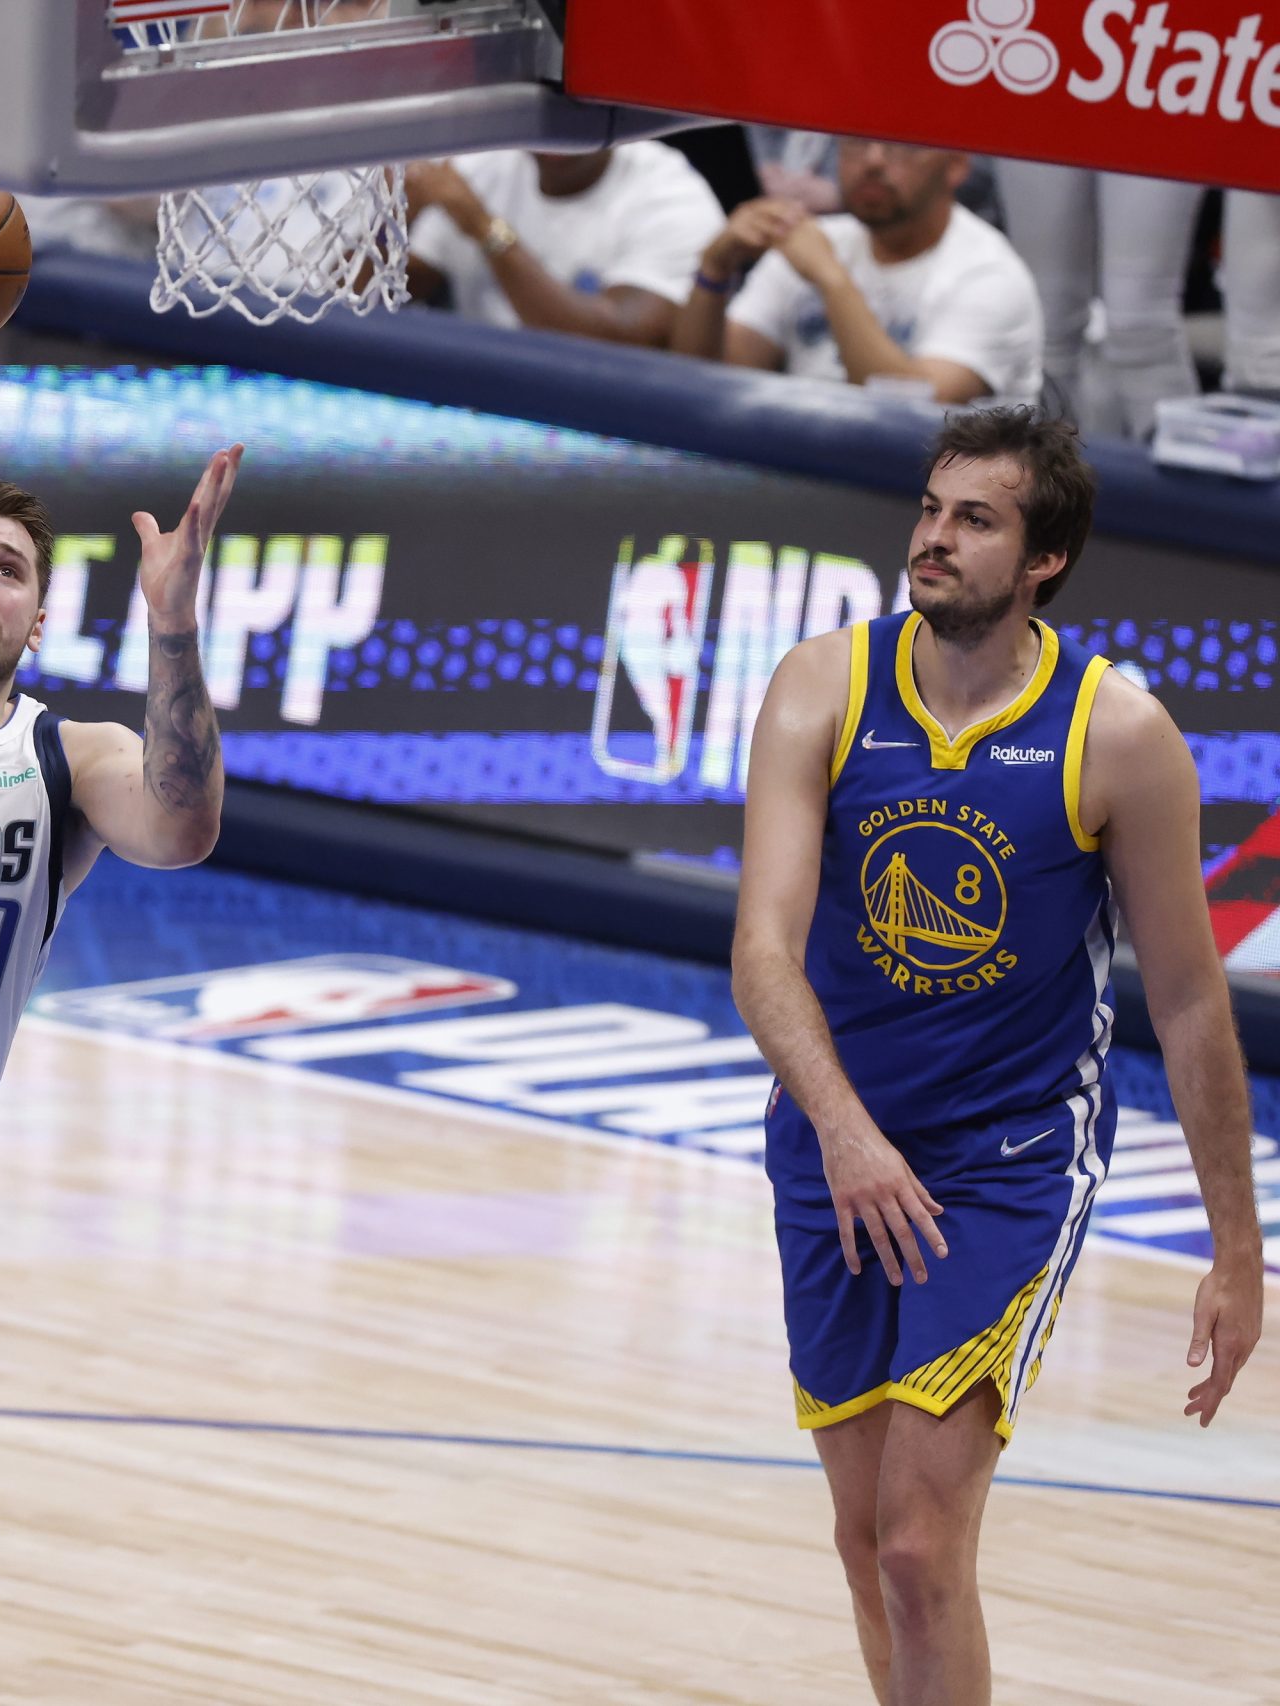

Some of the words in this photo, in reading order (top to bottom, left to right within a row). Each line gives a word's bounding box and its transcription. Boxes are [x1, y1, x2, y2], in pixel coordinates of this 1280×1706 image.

[990, 745, 1055, 762] Rakuten
[858, 798, 947, 837] GOLDEN
[956, 805, 1017, 860] STATE
[955, 863, 982, 905] 8
[856, 923, 1019, 996] WARRIORS
